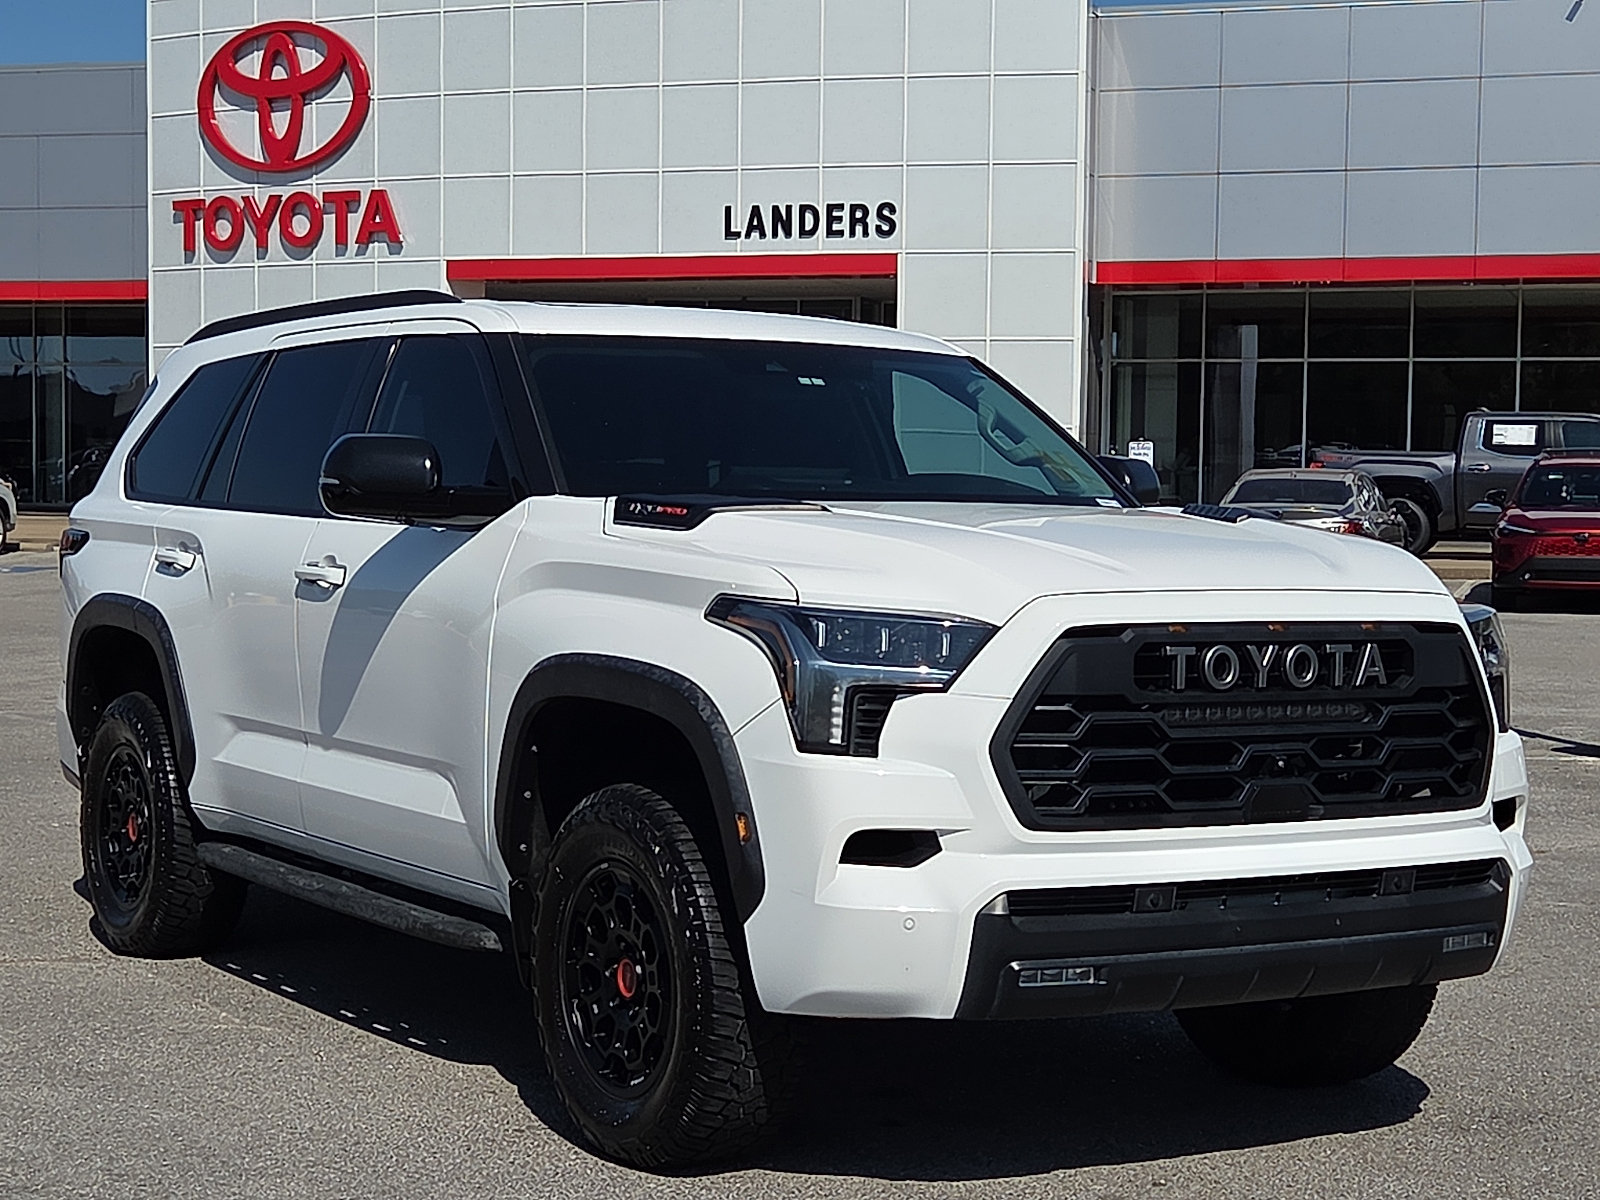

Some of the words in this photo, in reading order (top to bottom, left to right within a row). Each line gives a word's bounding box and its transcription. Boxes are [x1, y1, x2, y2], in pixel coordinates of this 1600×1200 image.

[172, 190, 402, 253] TOYOTA
[724, 202, 897, 240] LANDERS
[1164, 643, 1388, 691] TOYOTA
